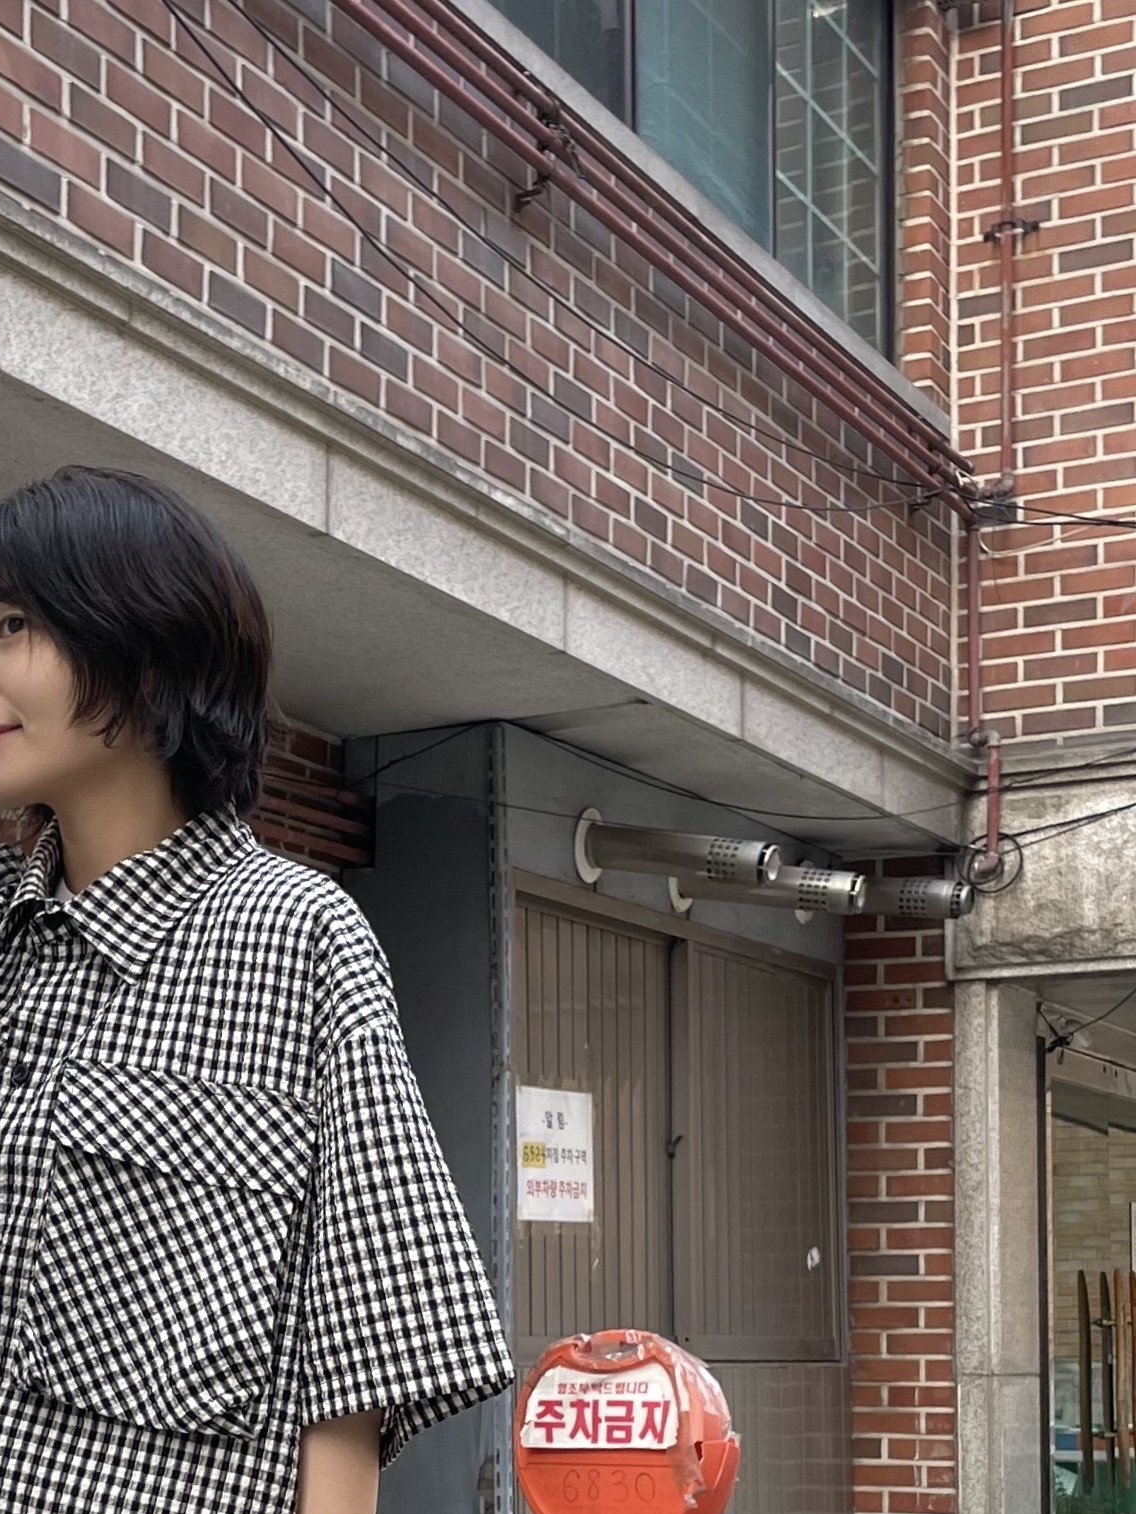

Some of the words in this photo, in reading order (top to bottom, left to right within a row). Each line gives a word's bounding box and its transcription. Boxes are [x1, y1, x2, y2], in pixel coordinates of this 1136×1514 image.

[559, 1181, 587, 1199] 주차금지
[534, 1397, 671, 1445] 주차금지
[562, 1468, 656, 1504] 6830
